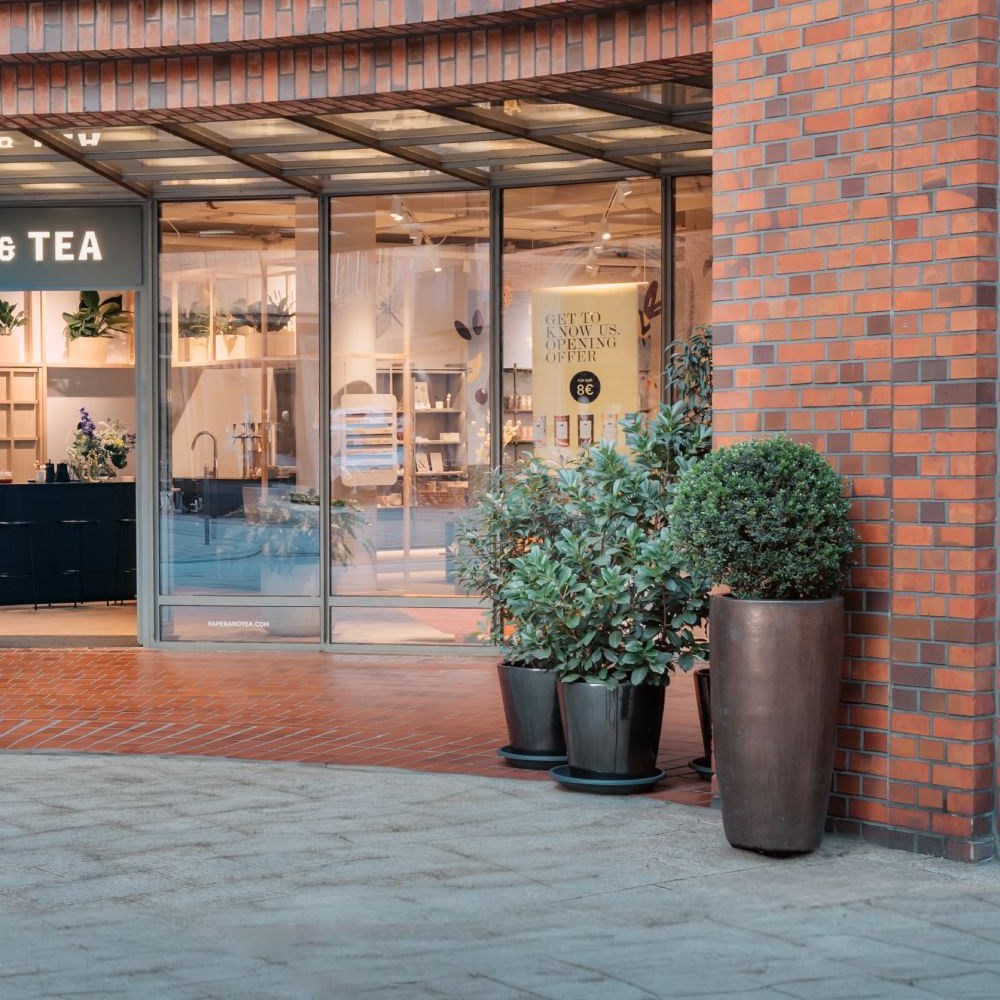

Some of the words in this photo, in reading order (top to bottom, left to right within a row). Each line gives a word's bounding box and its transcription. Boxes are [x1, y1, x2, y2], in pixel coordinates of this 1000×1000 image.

[27, 230, 103, 262] TEA
[545, 312, 577, 325] GET
[581, 311, 602, 324] TO
[546, 325, 593, 338] KNOW
[599, 323, 621, 336] US.
[545, 336, 617, 350] OPENING
[545, 350, 597, 363] OFFER
[576, 383, 595, 396] 8€
[207, 620, 270, 628] PAPERANDTEA.COM
